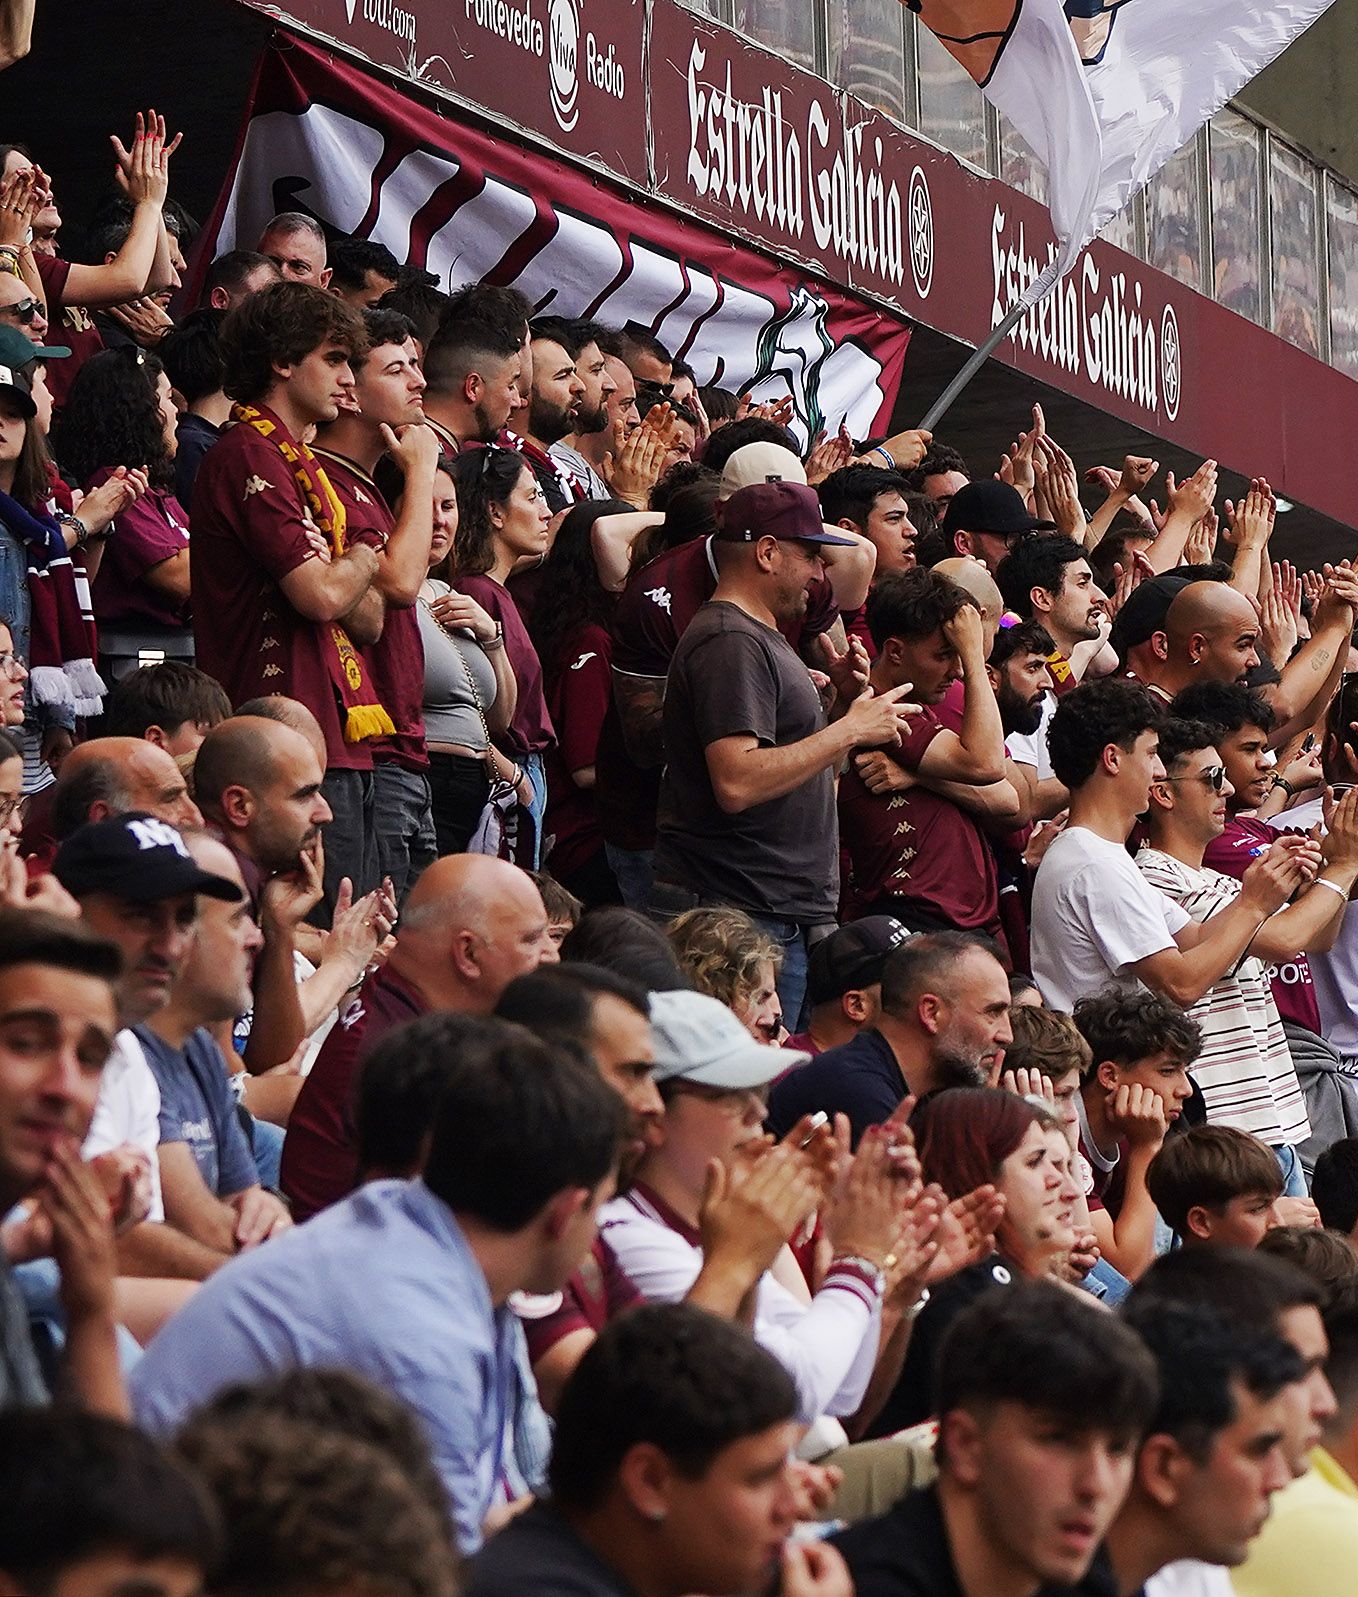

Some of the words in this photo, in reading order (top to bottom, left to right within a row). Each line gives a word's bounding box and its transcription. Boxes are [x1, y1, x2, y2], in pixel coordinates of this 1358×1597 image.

[587, 33, 624, 99] Radio
[687, 38, 804, 239] Estrella
[808, 100, 904, 287] Galicia
[1082, 252, 1158, 412] Galicia
